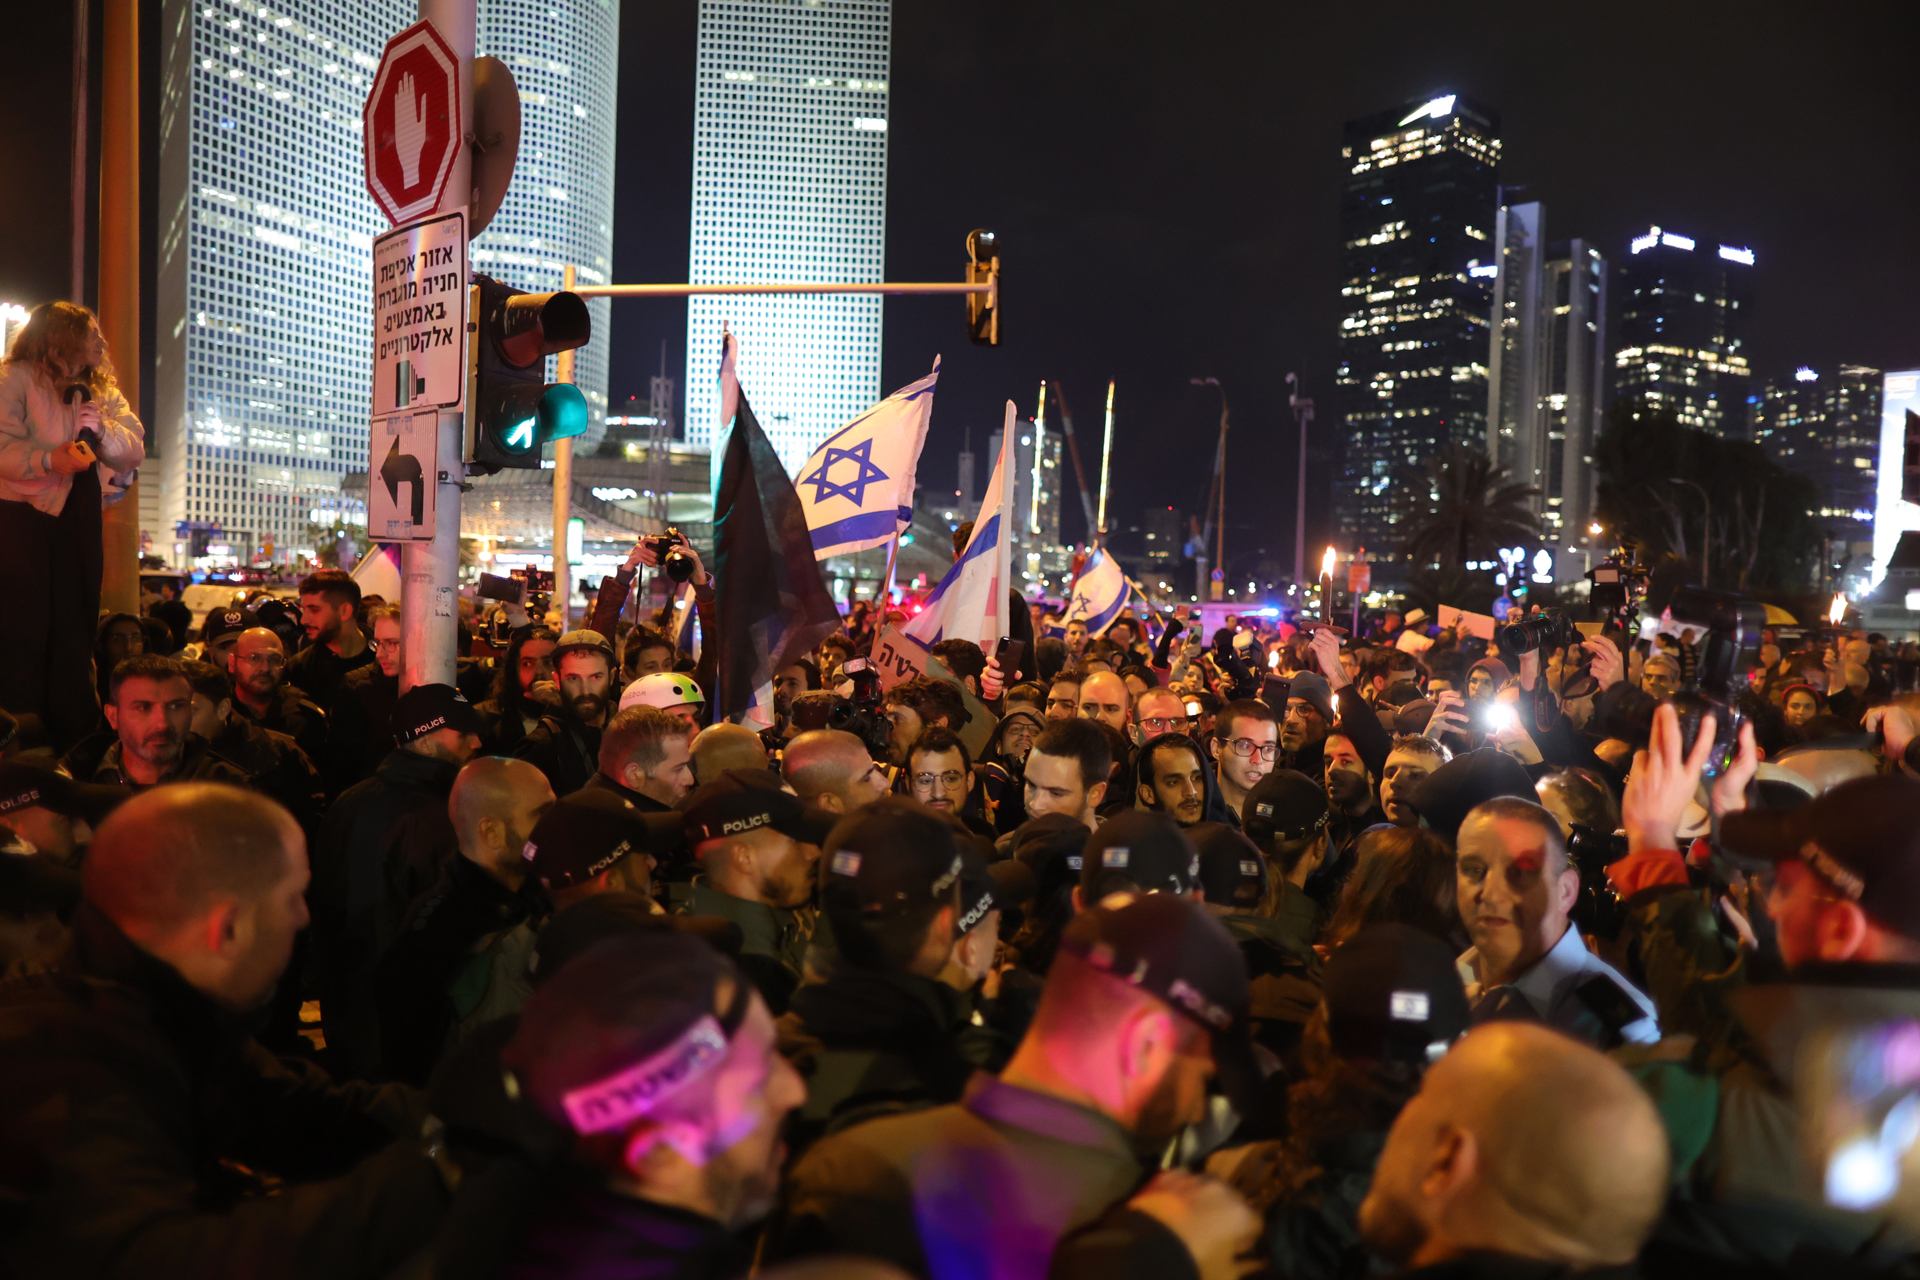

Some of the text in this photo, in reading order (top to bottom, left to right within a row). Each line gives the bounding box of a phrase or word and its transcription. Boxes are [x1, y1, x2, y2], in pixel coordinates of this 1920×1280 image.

[380, 245, 453, 284] אזור אכיפת
[378, 272, 458, 311] חניה מוגברת
[386, 302, 445, 333] באמצעים
[380, 325, 454, 361] אלקטרוניים
[414, 716, 446, 736] POLICE
[723, 812, 772, 835] POLICE
[588, 840, 631, 876] POLICE
[958, 892, 994, 933] POLICE
